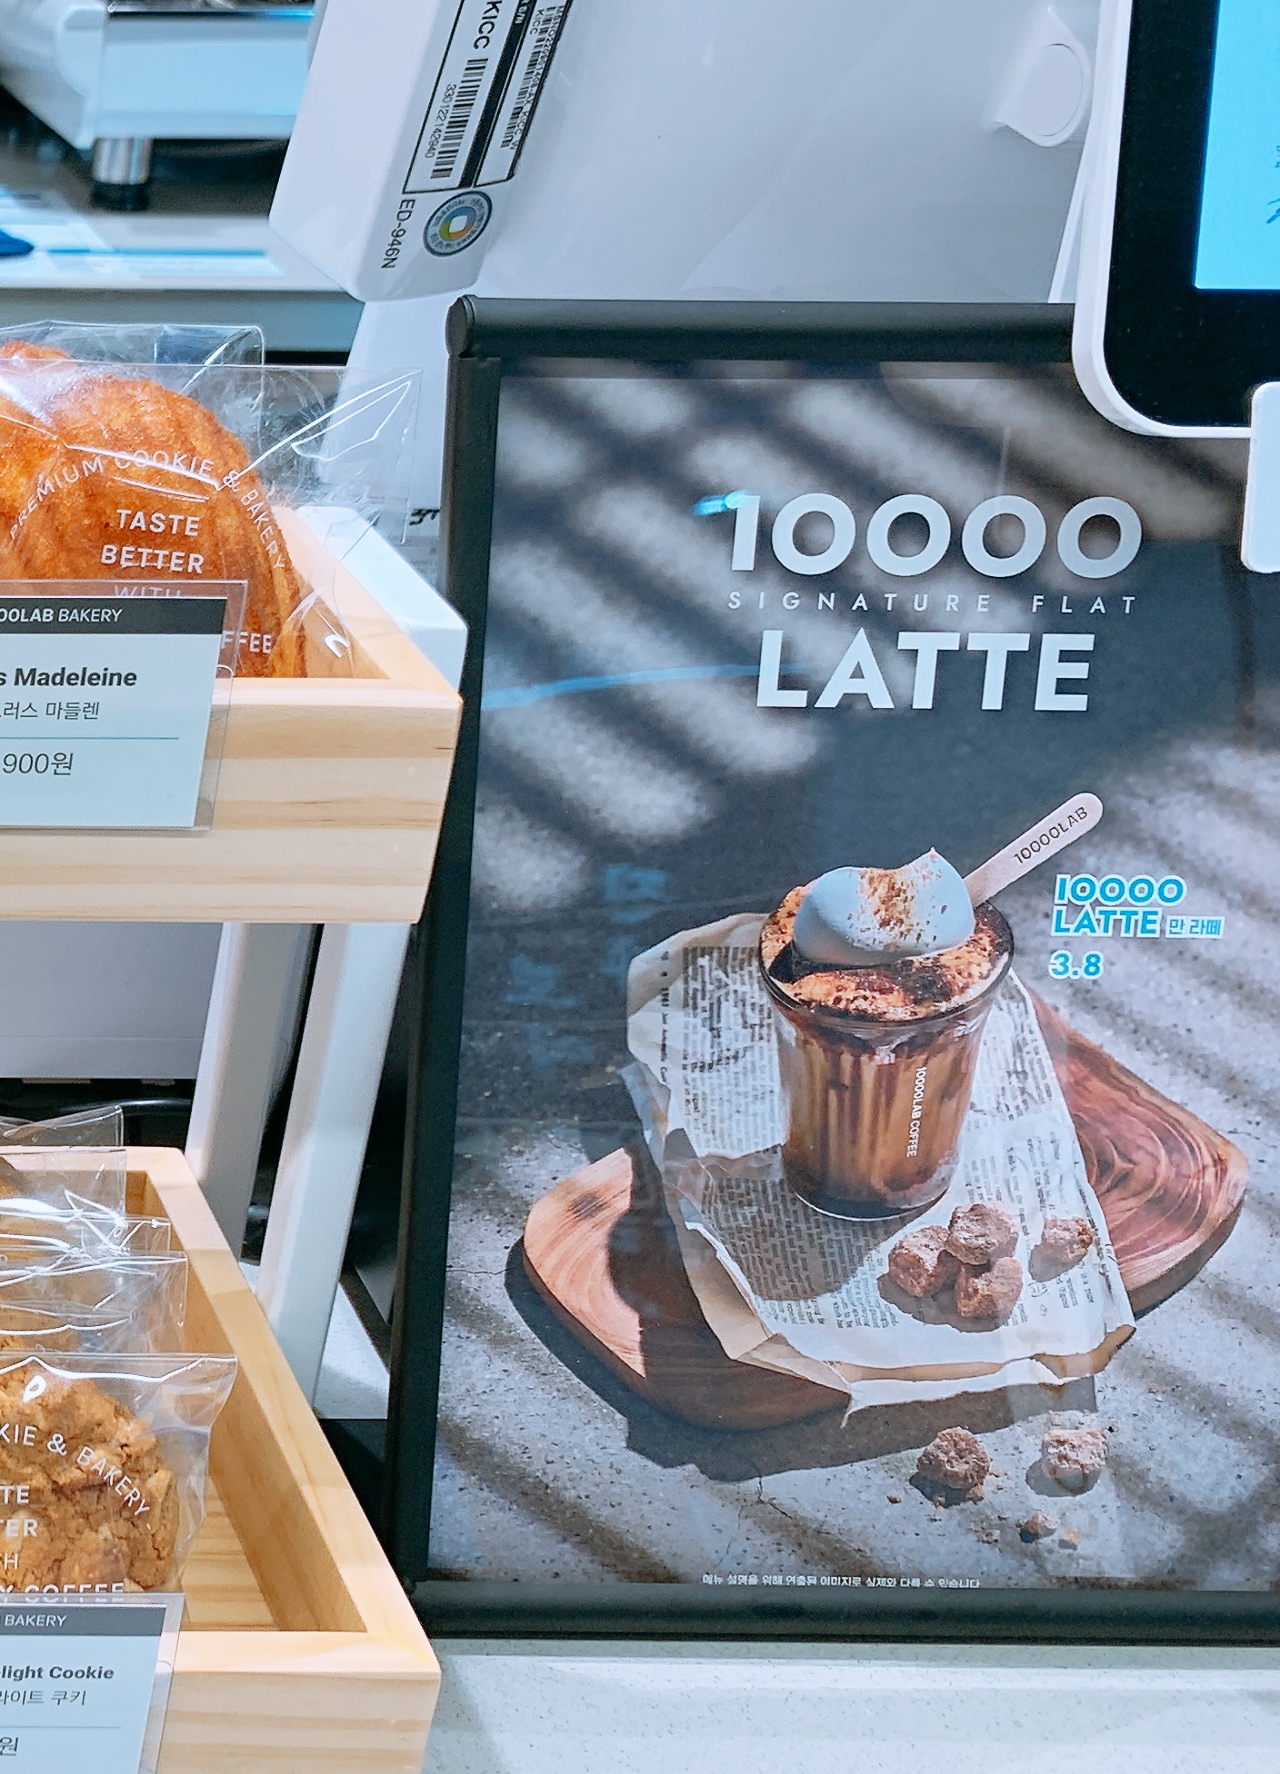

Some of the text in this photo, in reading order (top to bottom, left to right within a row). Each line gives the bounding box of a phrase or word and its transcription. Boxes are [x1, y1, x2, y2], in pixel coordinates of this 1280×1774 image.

[473, 0, 504, 50] KICC
[381, 199, 416, 269] ED-946N
[116, 509, 200, 537] TASTE
[731, 493, 1143, 579] 10000
[100, 544, 205, 575] BETTER
[58, 608, 123, 622] BAKERY
[727, 591, 1136, 615] SIGNATURE FLAT
[14, 667, 137, 686] Madeleine
[756, 626, 1096, 711] LATTE
[45, 702, 100, 720] 마들렌
[1013, 806, 1088, 864] 10000LAB
[1054, 875, 1186, 906] 10000
[1053, 907, 1161, 937] LATTE
[1050, 951, 1103, 978] 3.8
[906, 1120, 920, 1157] COFFEE
[46, 1433, 68, 1456] &
[77, 1446, 151, 1517] BAKERY
[4, 1614, 67, 1627] BAKERY
[49, 1665, 115, 1680] Cookie
[51, 1690, 86, 1705] 쿠키
